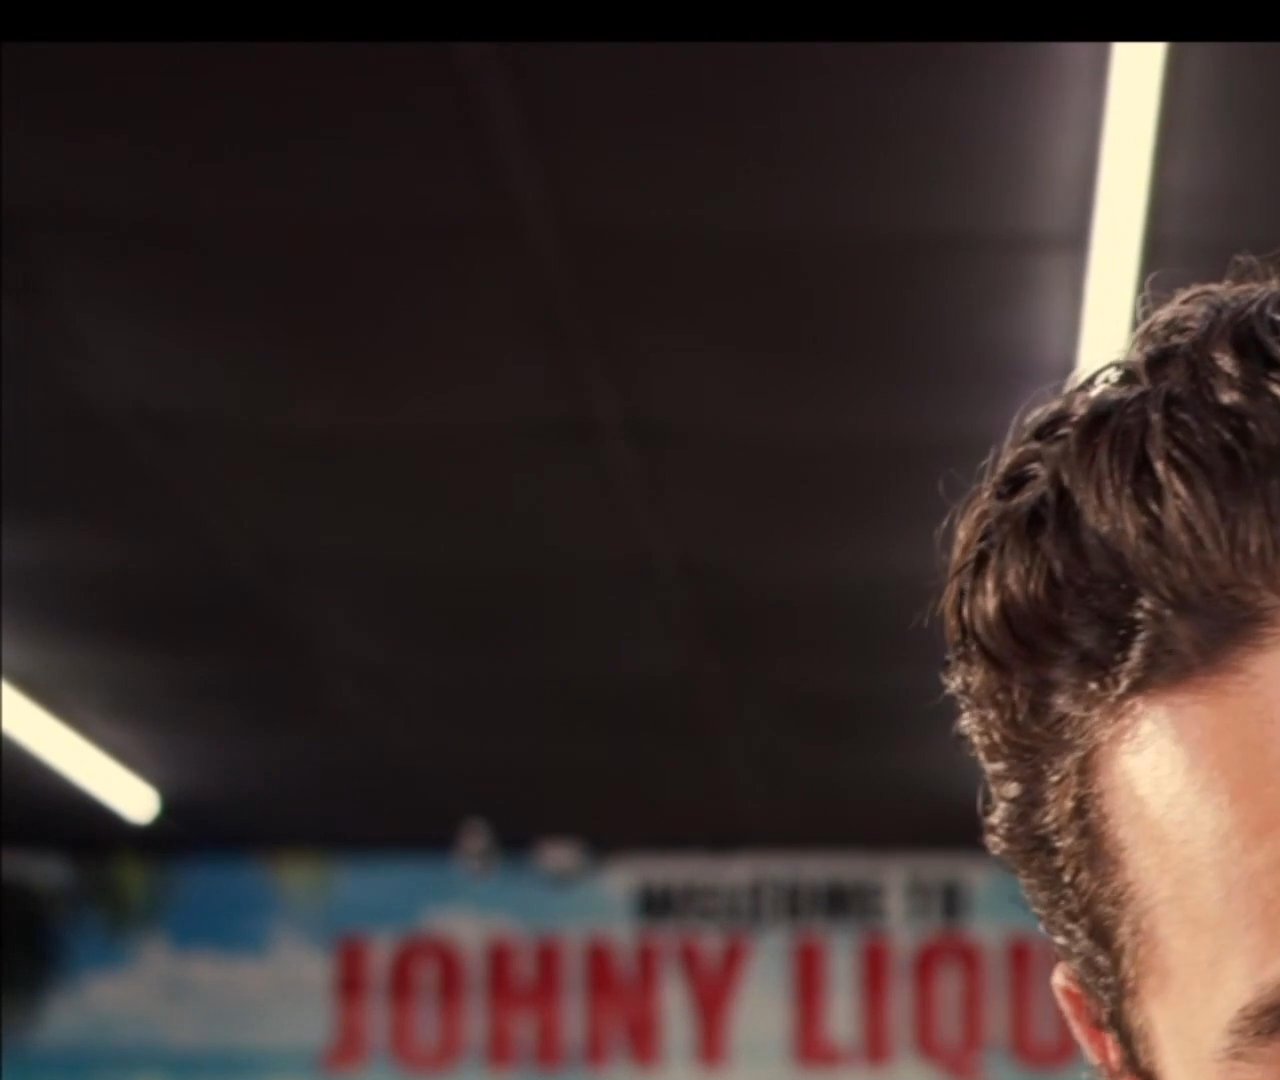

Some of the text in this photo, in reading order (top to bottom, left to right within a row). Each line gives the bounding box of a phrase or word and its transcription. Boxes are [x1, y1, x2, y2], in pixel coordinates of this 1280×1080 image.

[637, 880, 966, 924] WELCOME TO
[323, 930, 748, 1077] JOHNY
